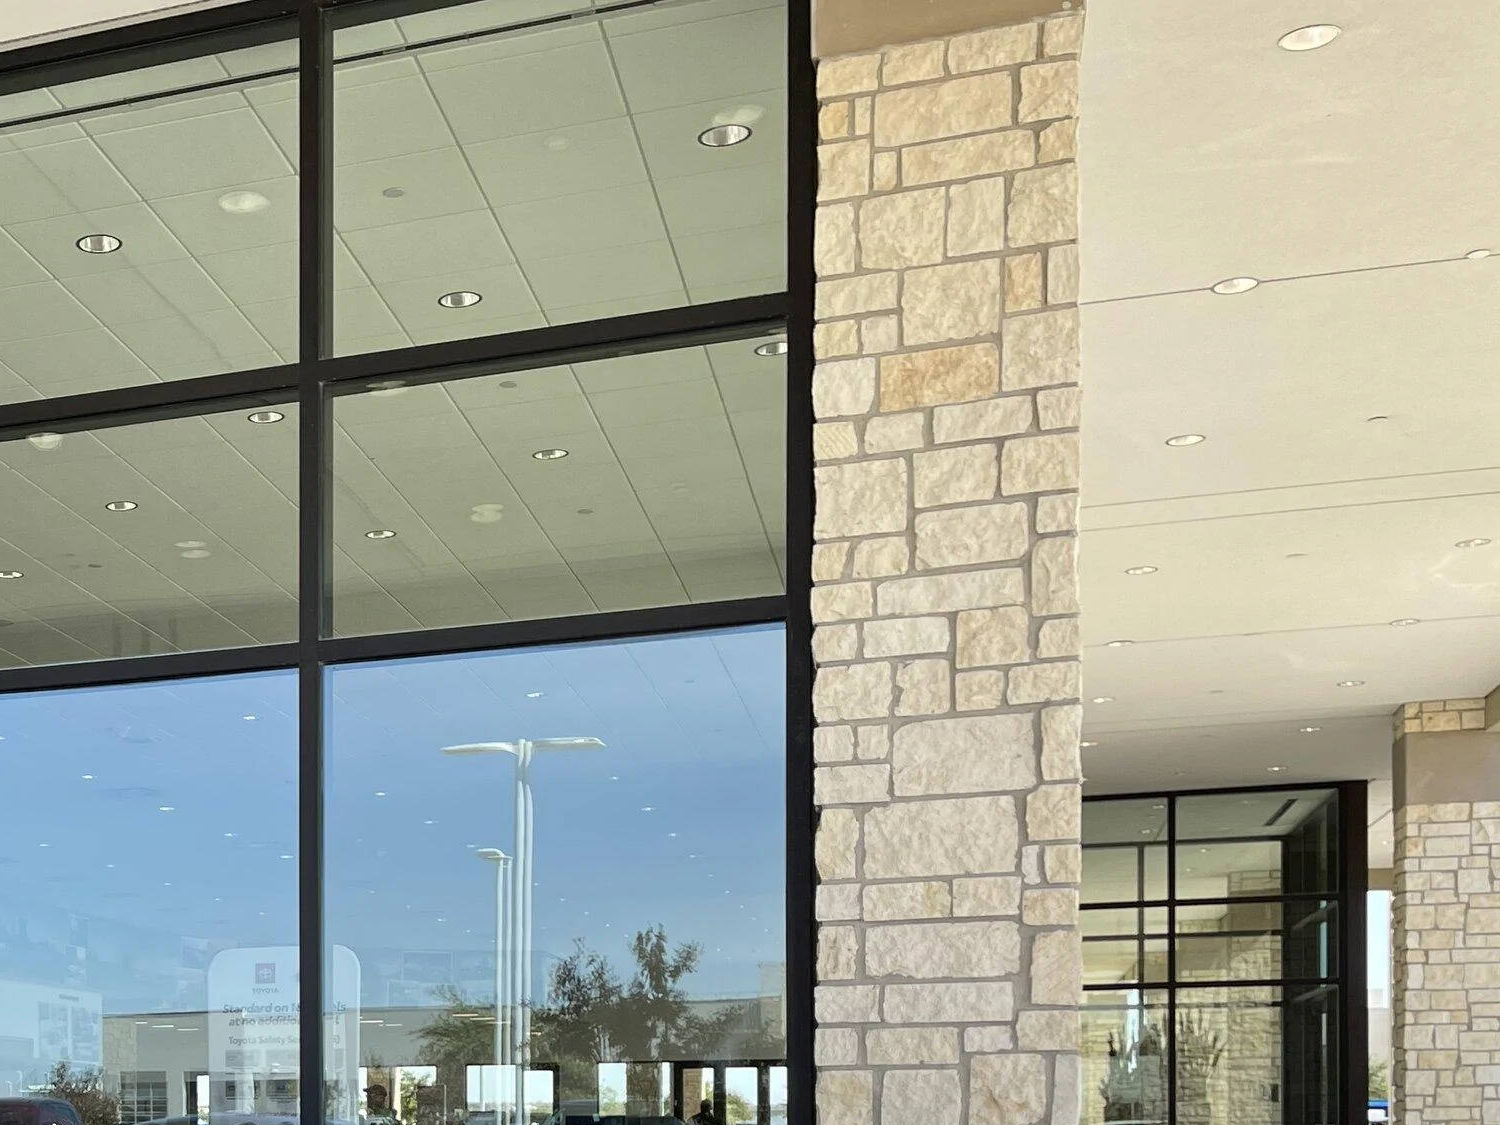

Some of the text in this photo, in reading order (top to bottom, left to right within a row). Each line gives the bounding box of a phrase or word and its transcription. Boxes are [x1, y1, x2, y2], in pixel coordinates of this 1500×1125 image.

[222, 1003, 273, 1013] Standard
[275, 1005, 288, 1013] on
[228, 1014, 299, 1026] at no additio
[228, 1036, 256, 1046] Toyota
[258, 1035, 285, 1046] Safety
